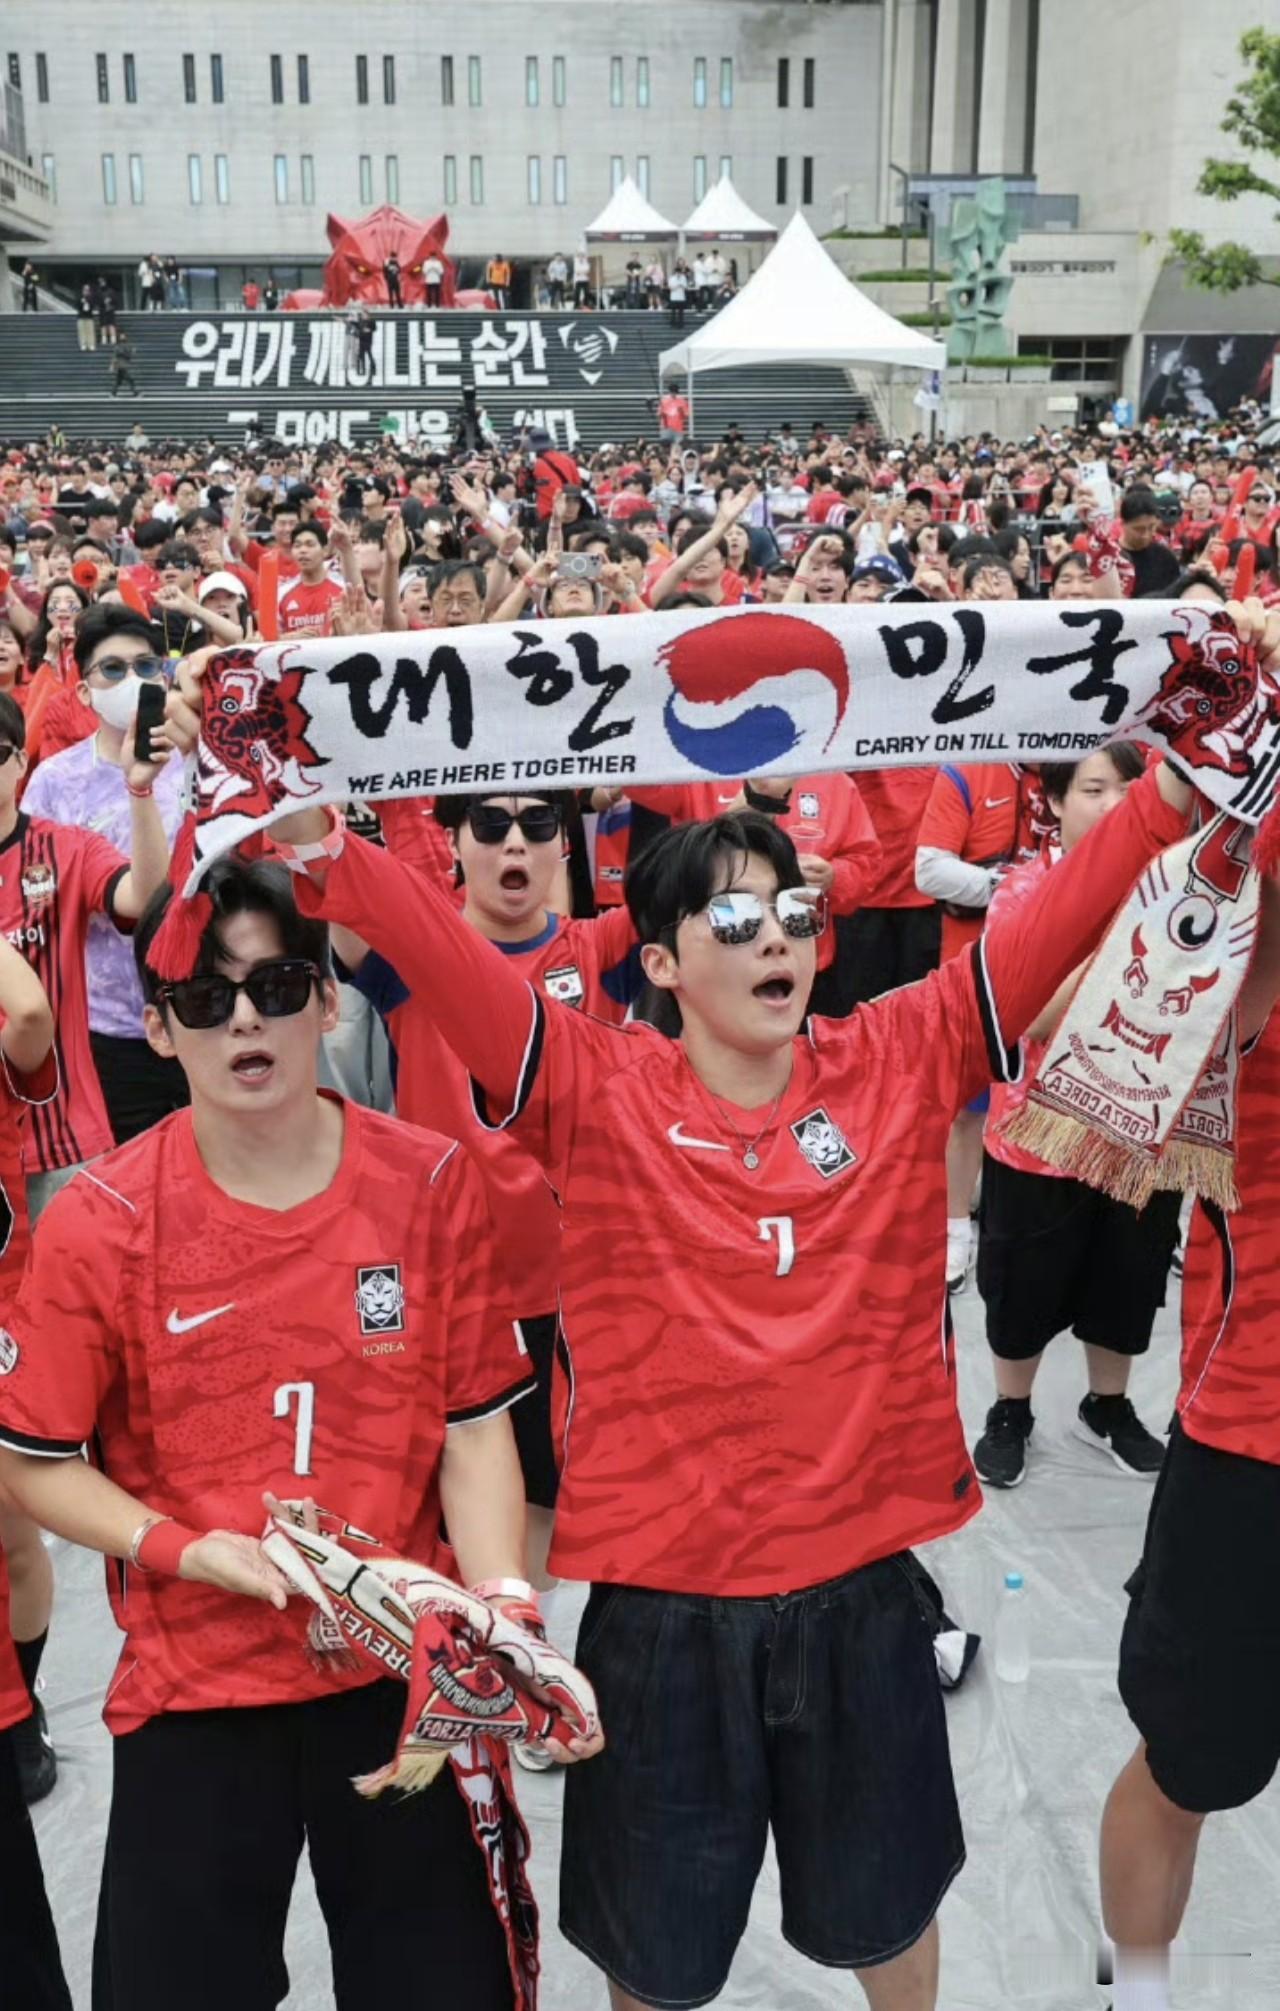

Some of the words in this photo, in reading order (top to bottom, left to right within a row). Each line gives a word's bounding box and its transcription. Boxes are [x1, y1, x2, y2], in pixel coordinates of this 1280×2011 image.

[175, 321, 296, 387] 우리가
[470, 321, 549, 386] 순간
[855, 735, 930, 757] CARRY
[934, 733, 965, 751] ON
[970, 732, 1010, 749] TILL
[1017, 731, 1109, 750] TOMORR
[348, 774, 384, 794] WE
[388, 768, 438, 790] ARE
[441, 761, 506, 786] HERE
[512, 754, 637, 780] TOGETHER
[755, 1215, 796, 1277] 7
[362, 1341, 405, 1358] KOREA
[271, 1381, 315, 1476] 7
[422, 1718, 474, 1740] FORZA
